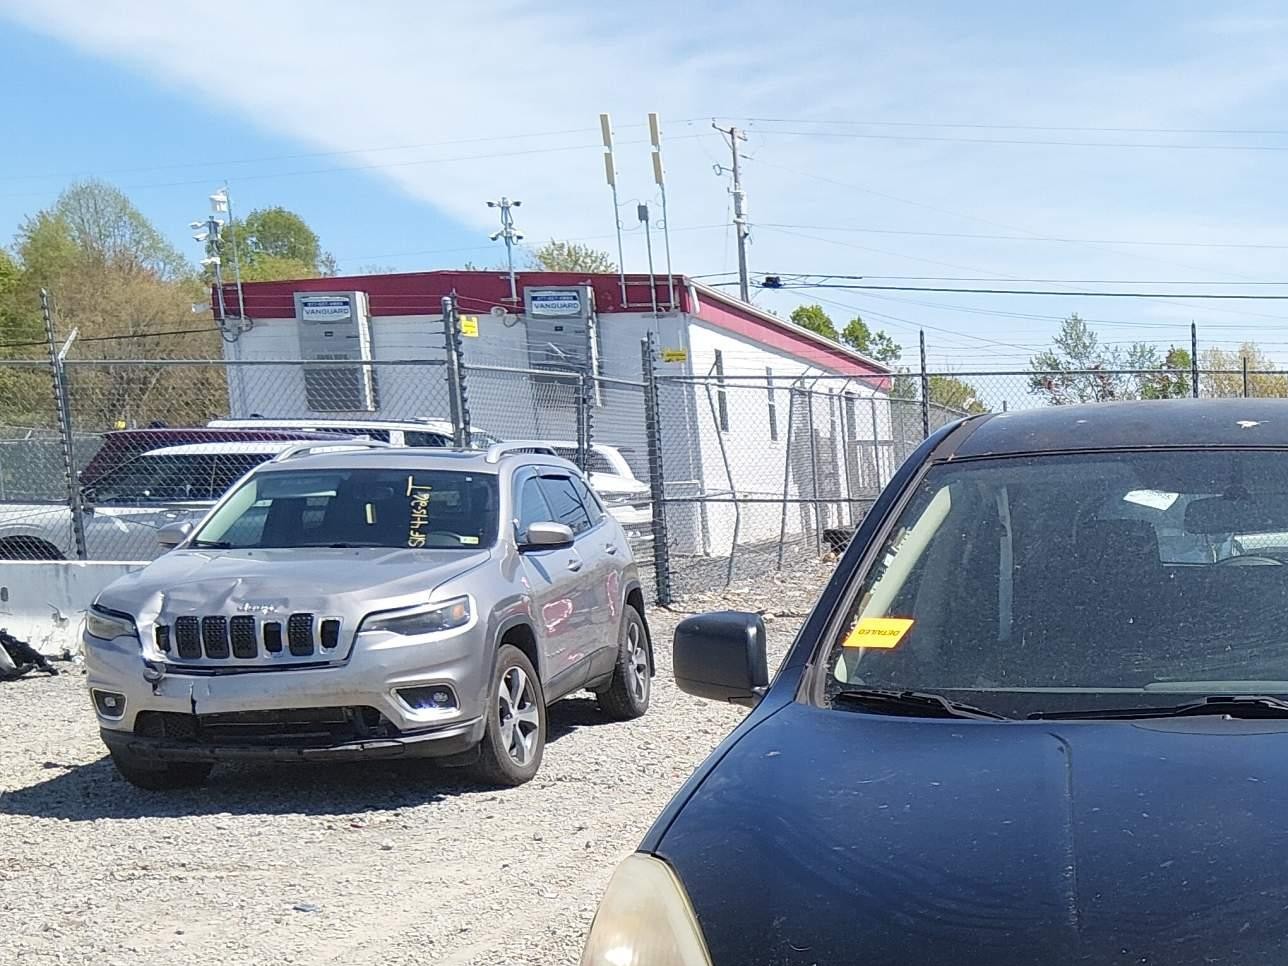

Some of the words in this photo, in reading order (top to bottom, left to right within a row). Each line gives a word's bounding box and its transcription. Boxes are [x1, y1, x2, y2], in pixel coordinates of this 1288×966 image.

[304, 307, 349, 315] VANGUARD
[406, 475, 433, 497] T
[858, 628, 902, 637] DETAILED
